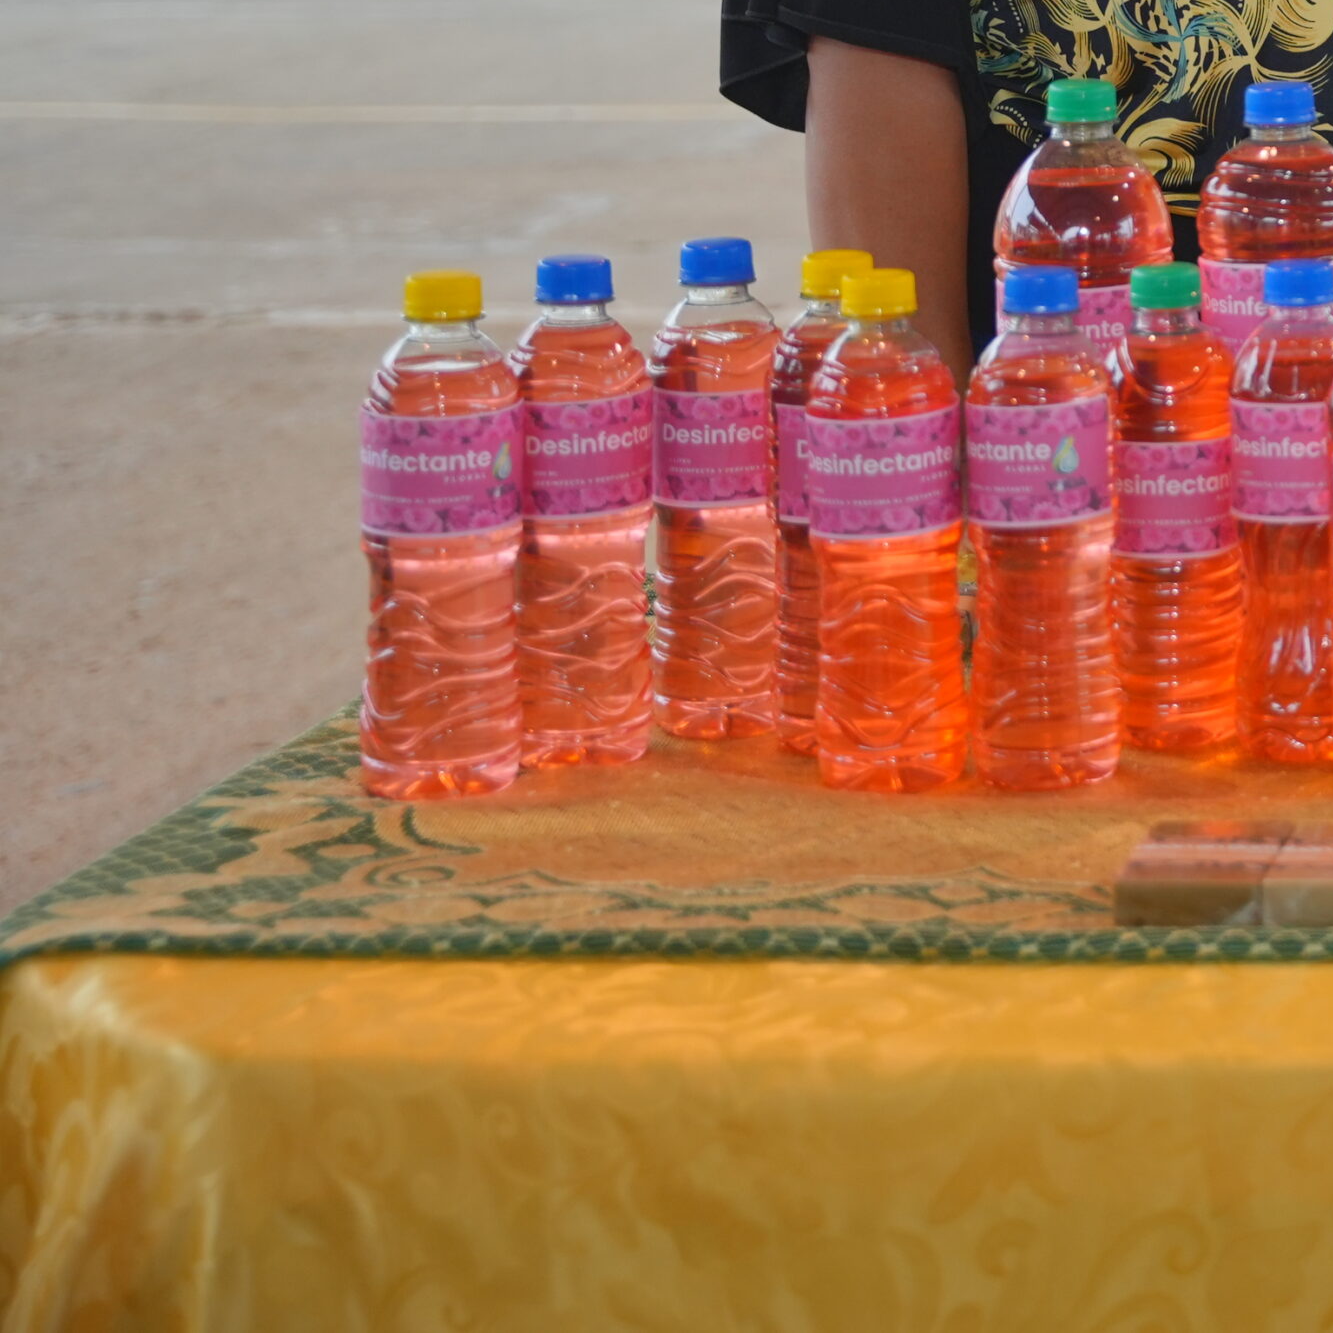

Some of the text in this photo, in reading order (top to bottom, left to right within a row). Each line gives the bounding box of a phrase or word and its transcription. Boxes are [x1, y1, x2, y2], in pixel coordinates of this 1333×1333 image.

[525, 424, 650, 455] Desinfecta
[663, 423, 765, 445] Desinfec
[1232, 433, 1328, 458] Desinfect
